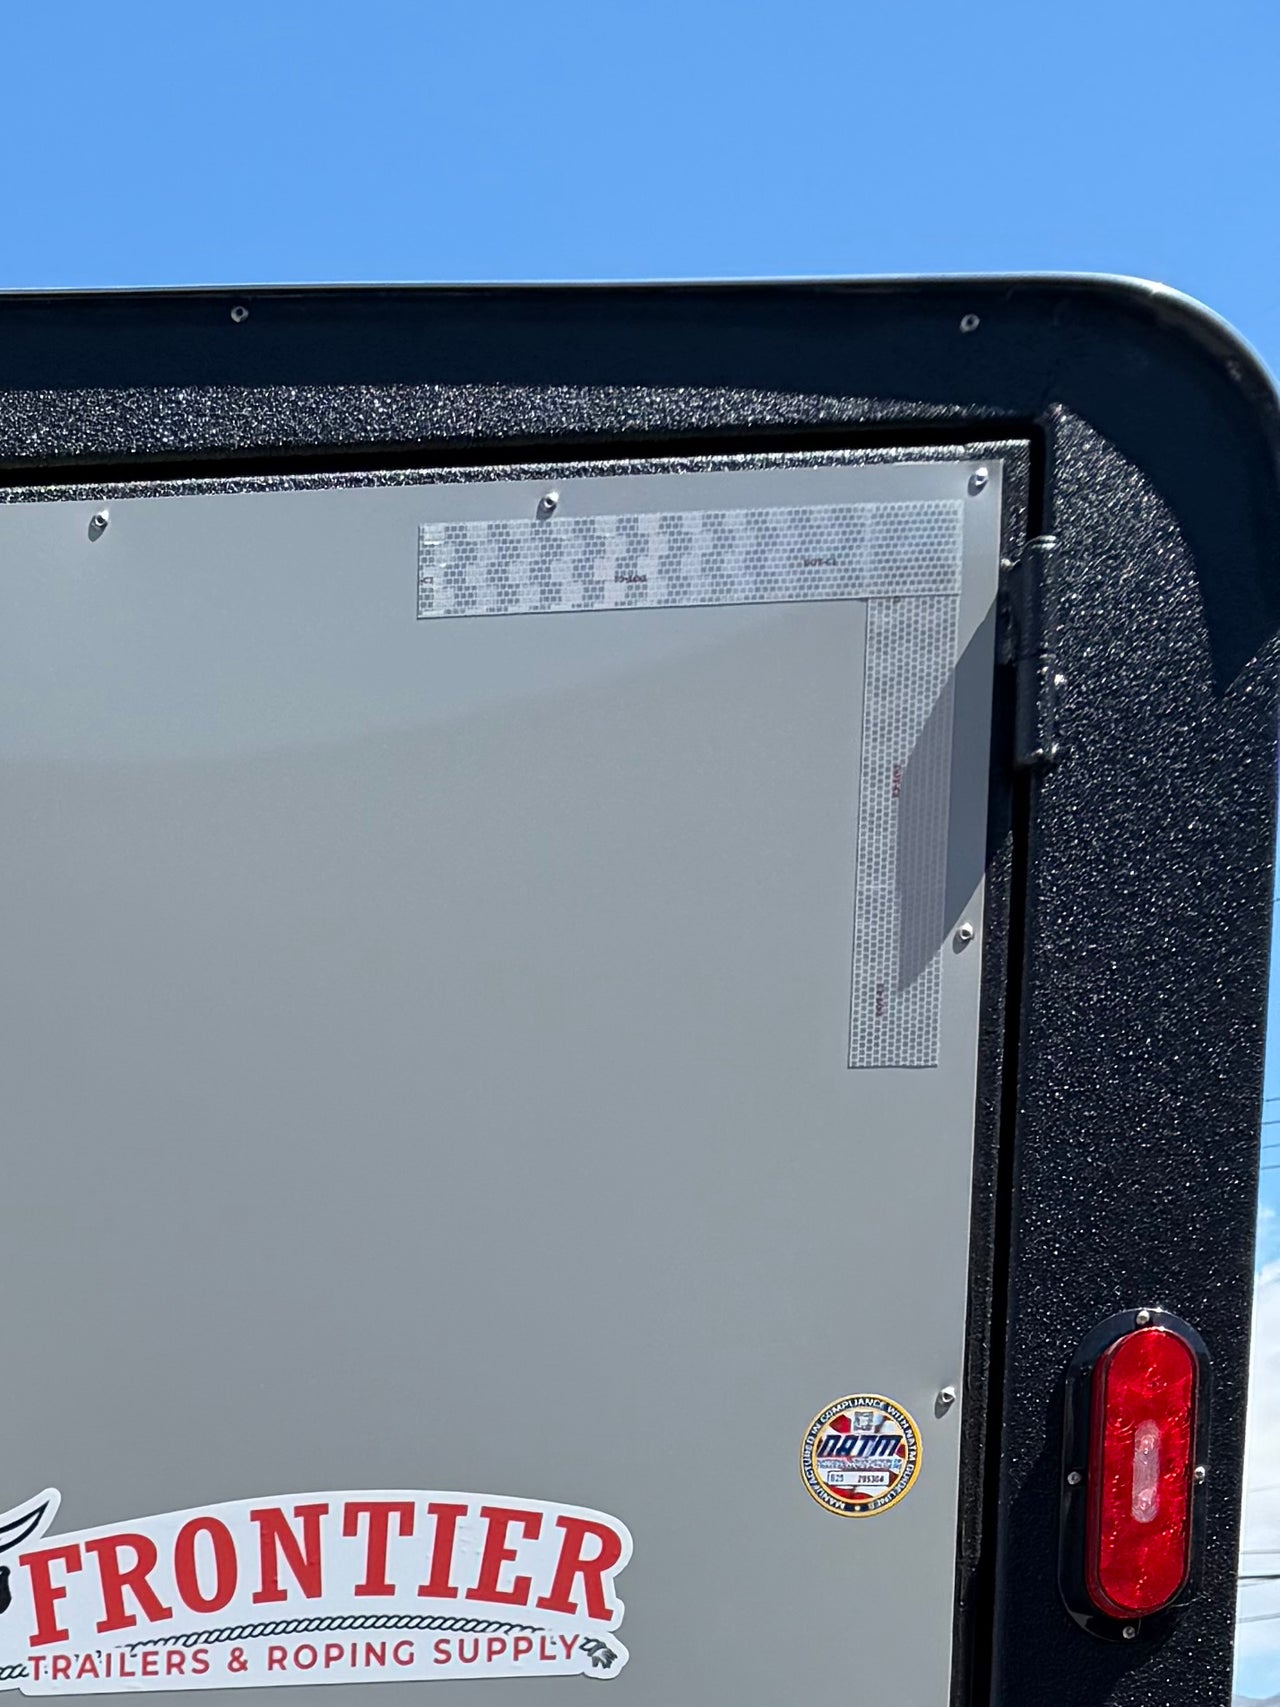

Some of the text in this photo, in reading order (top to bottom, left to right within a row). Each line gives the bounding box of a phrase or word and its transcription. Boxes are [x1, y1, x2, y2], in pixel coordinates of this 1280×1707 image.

[18, 1500, 623, 1648] FRONTIER
[27, 1634, 581, 1681] TRAILERS & ROPING SUPPLY
